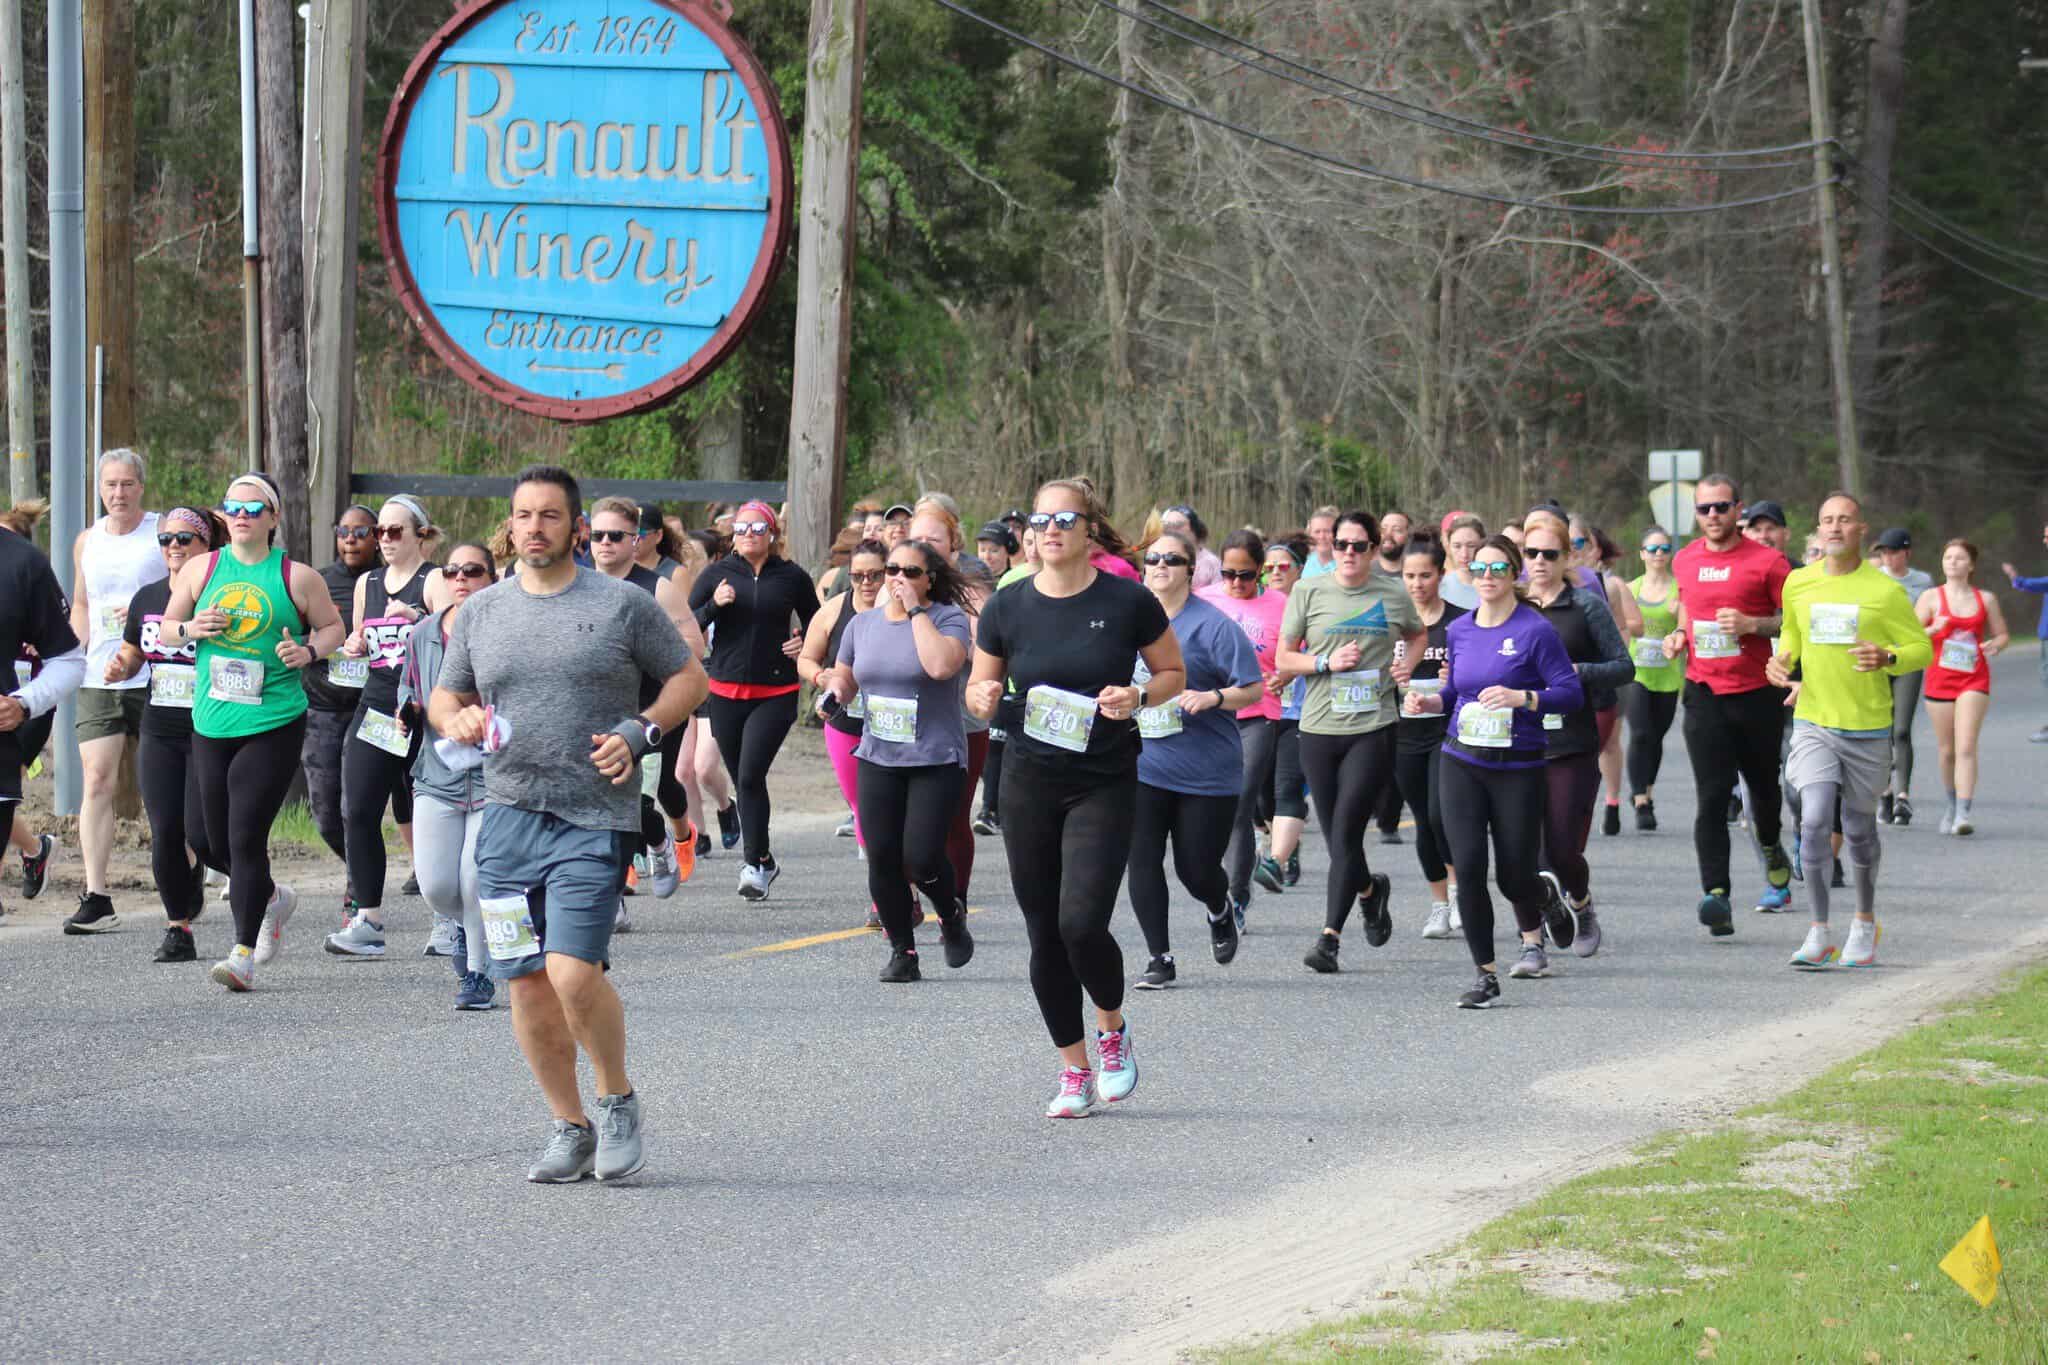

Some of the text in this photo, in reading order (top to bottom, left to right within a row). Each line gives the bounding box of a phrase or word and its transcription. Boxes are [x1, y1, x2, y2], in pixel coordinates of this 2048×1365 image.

[593, 15, 678, 55] 1864
[438, 62, 757, 189] Renault
[444, 203, 713, 306] Winery
[484, 309, 664, 355] Entrance
[1702, 634, 1729, 649] 731
[338, 660, 367, 678] 850
[159, 678, 186, 697] 849
[217, 671, 253, 690] 3883
[1343, 685, 1372, 701] 706
[876, 710, 904, 730] 893
[1039, 704, 1078, 735] 730
[1470, 716, 1500, 735] 720
